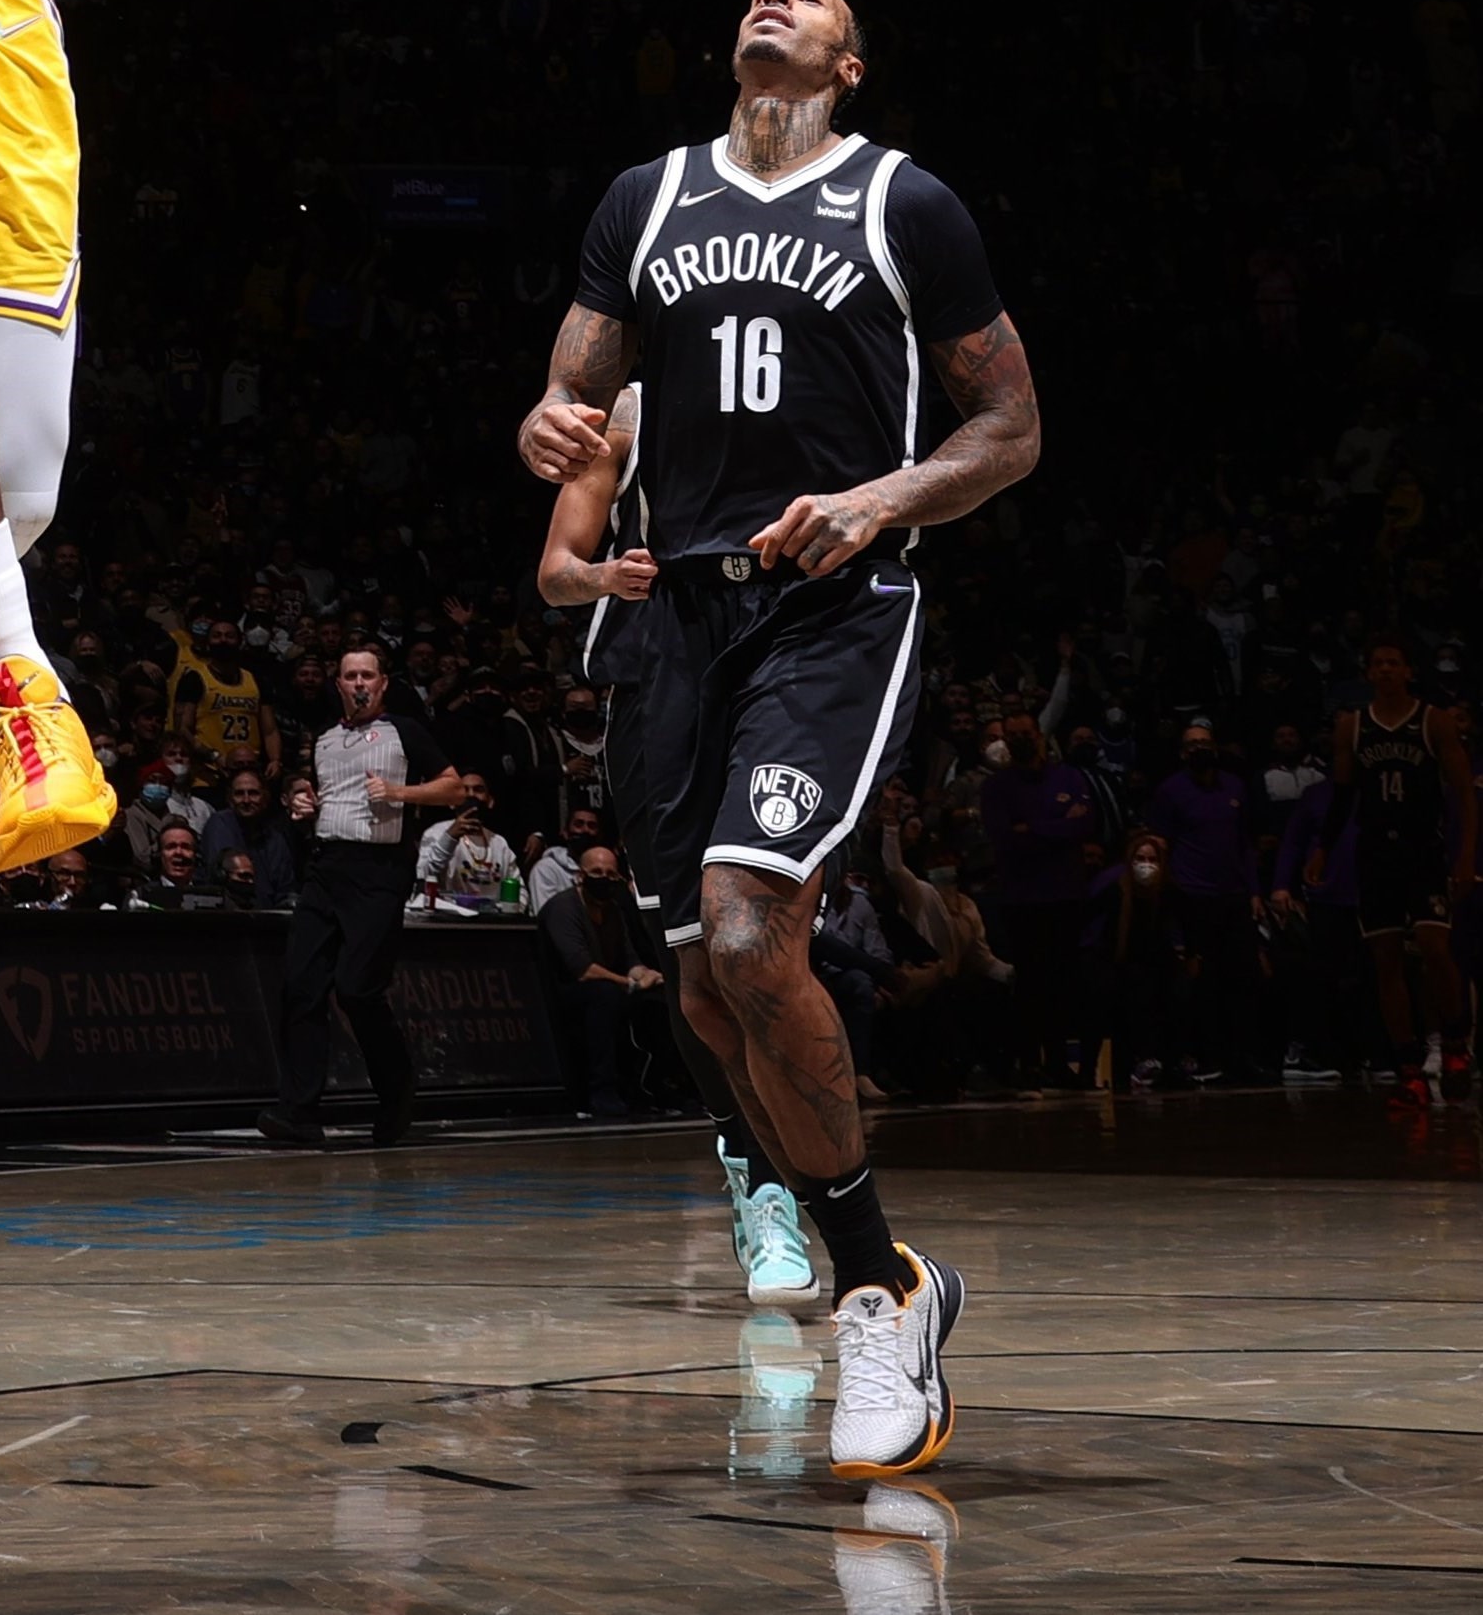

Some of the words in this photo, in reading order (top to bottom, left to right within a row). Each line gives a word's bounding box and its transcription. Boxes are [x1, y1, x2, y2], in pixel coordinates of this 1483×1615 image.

[816, 205, 857, 220] Webull
[647, 232, 866, 313] BROOKLYN
[710, 314, 784, 414] 16
[222, 714, 250, 742] 23
[753, 768, 818, 811] NETS
[1379, 770, 1405, 803] 14
[60, 971, 227, 1017] FANDUEL
[72, 1023, 235, 1054] SPORTSBOOK
[397, 1016, 532, 1043] PORTSBOOK
